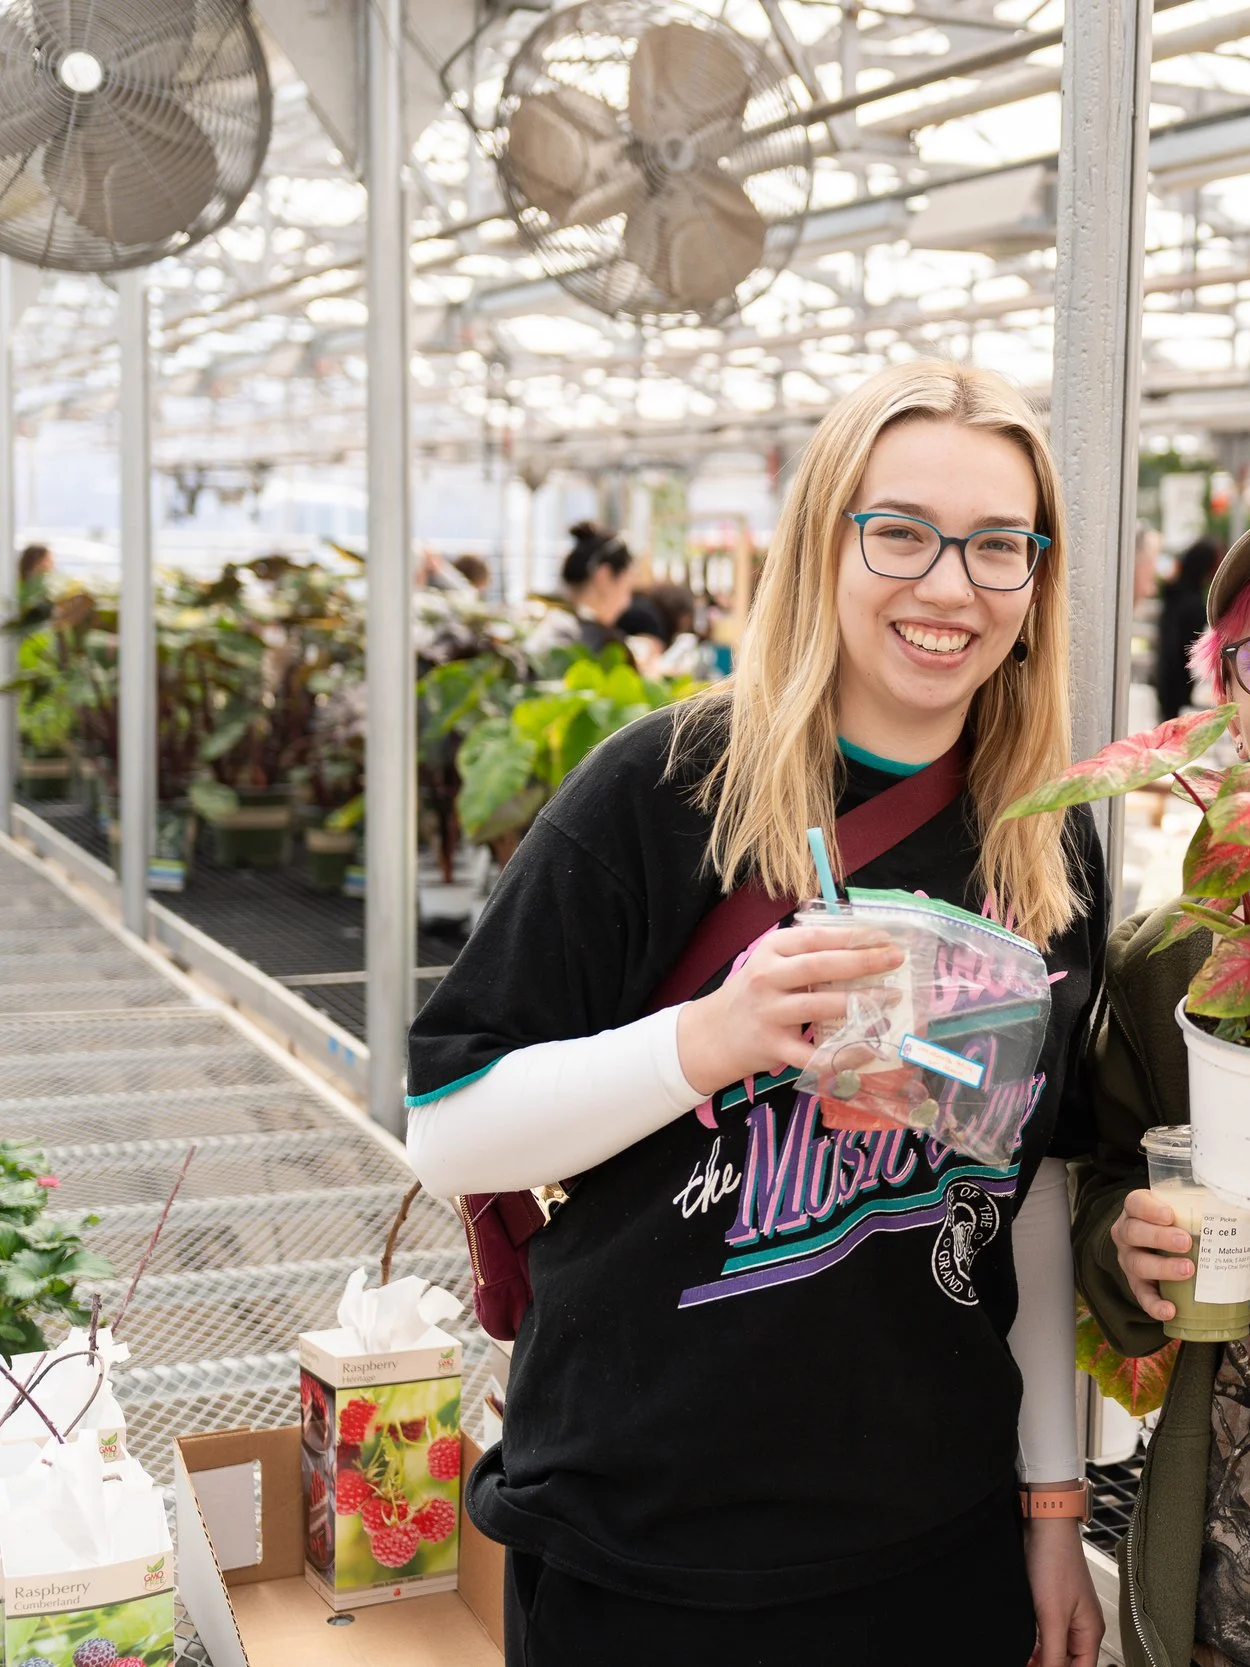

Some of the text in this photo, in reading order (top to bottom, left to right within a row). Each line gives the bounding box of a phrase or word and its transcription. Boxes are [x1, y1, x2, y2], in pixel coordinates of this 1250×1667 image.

[672, 1135, 742, 1219] the
[960, 1187, 993, 1228] OF THE
[938, 1250, 963, 1293] GRAND
[342, 1359, 398, 1375] Raspberry
[144, 1570, 164, 1582] GMO
[15, 1582, 91, 1600] Raspberry
[14, 1597, 81, 1611] Cumberland
